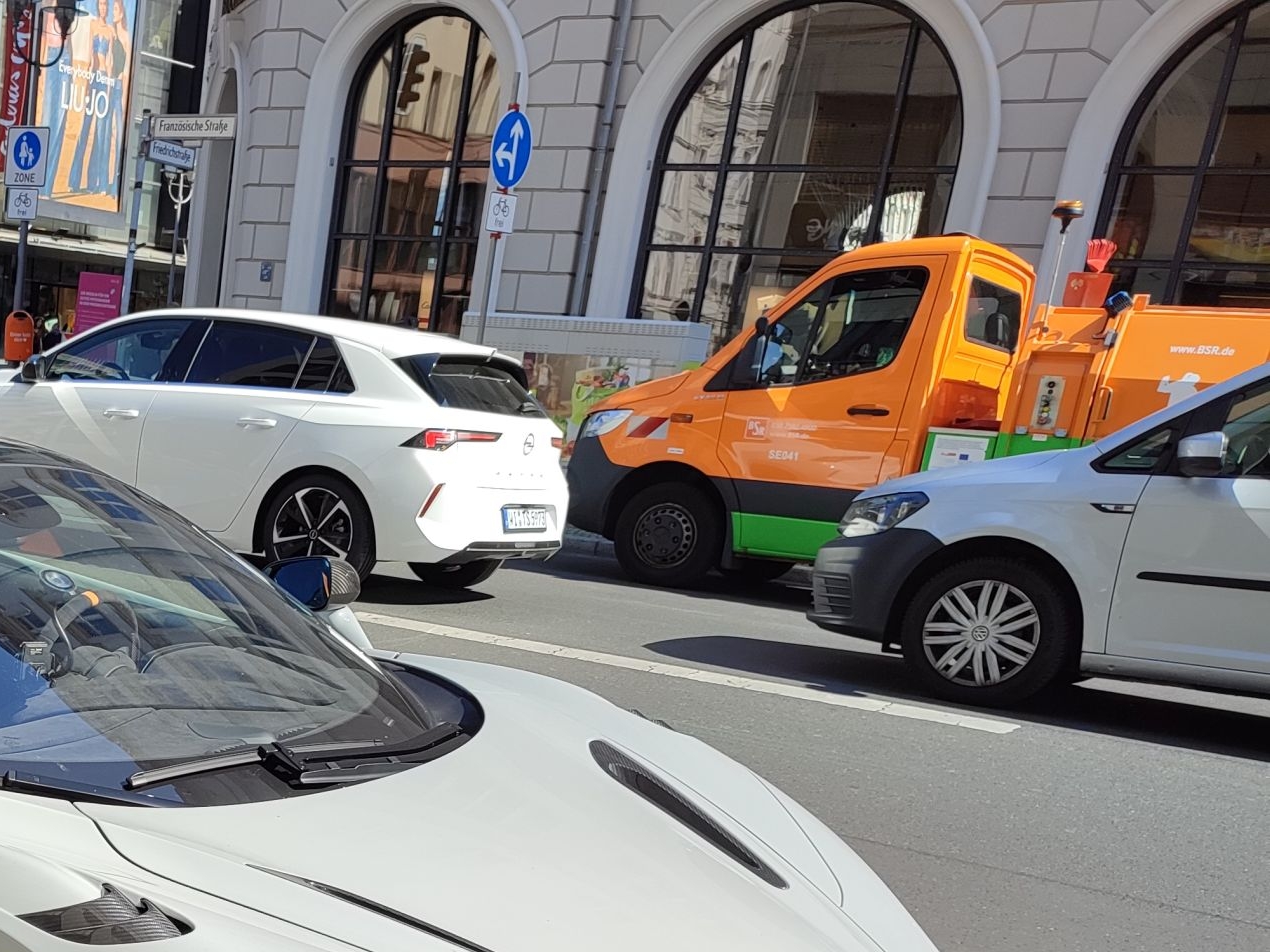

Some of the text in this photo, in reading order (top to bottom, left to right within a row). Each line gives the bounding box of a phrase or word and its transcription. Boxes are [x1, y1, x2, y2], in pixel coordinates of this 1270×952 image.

[59, 59, 95, 84] Everybody
[159, 119, 228, 134] Französische Straße
[152, 141, 191, 164] Friedrichstraße
[14, 172, 36, 183] ZONE
[1170, 345, 1235, 356] www.BSR.de
[767, 449, 798, 461] SE041
